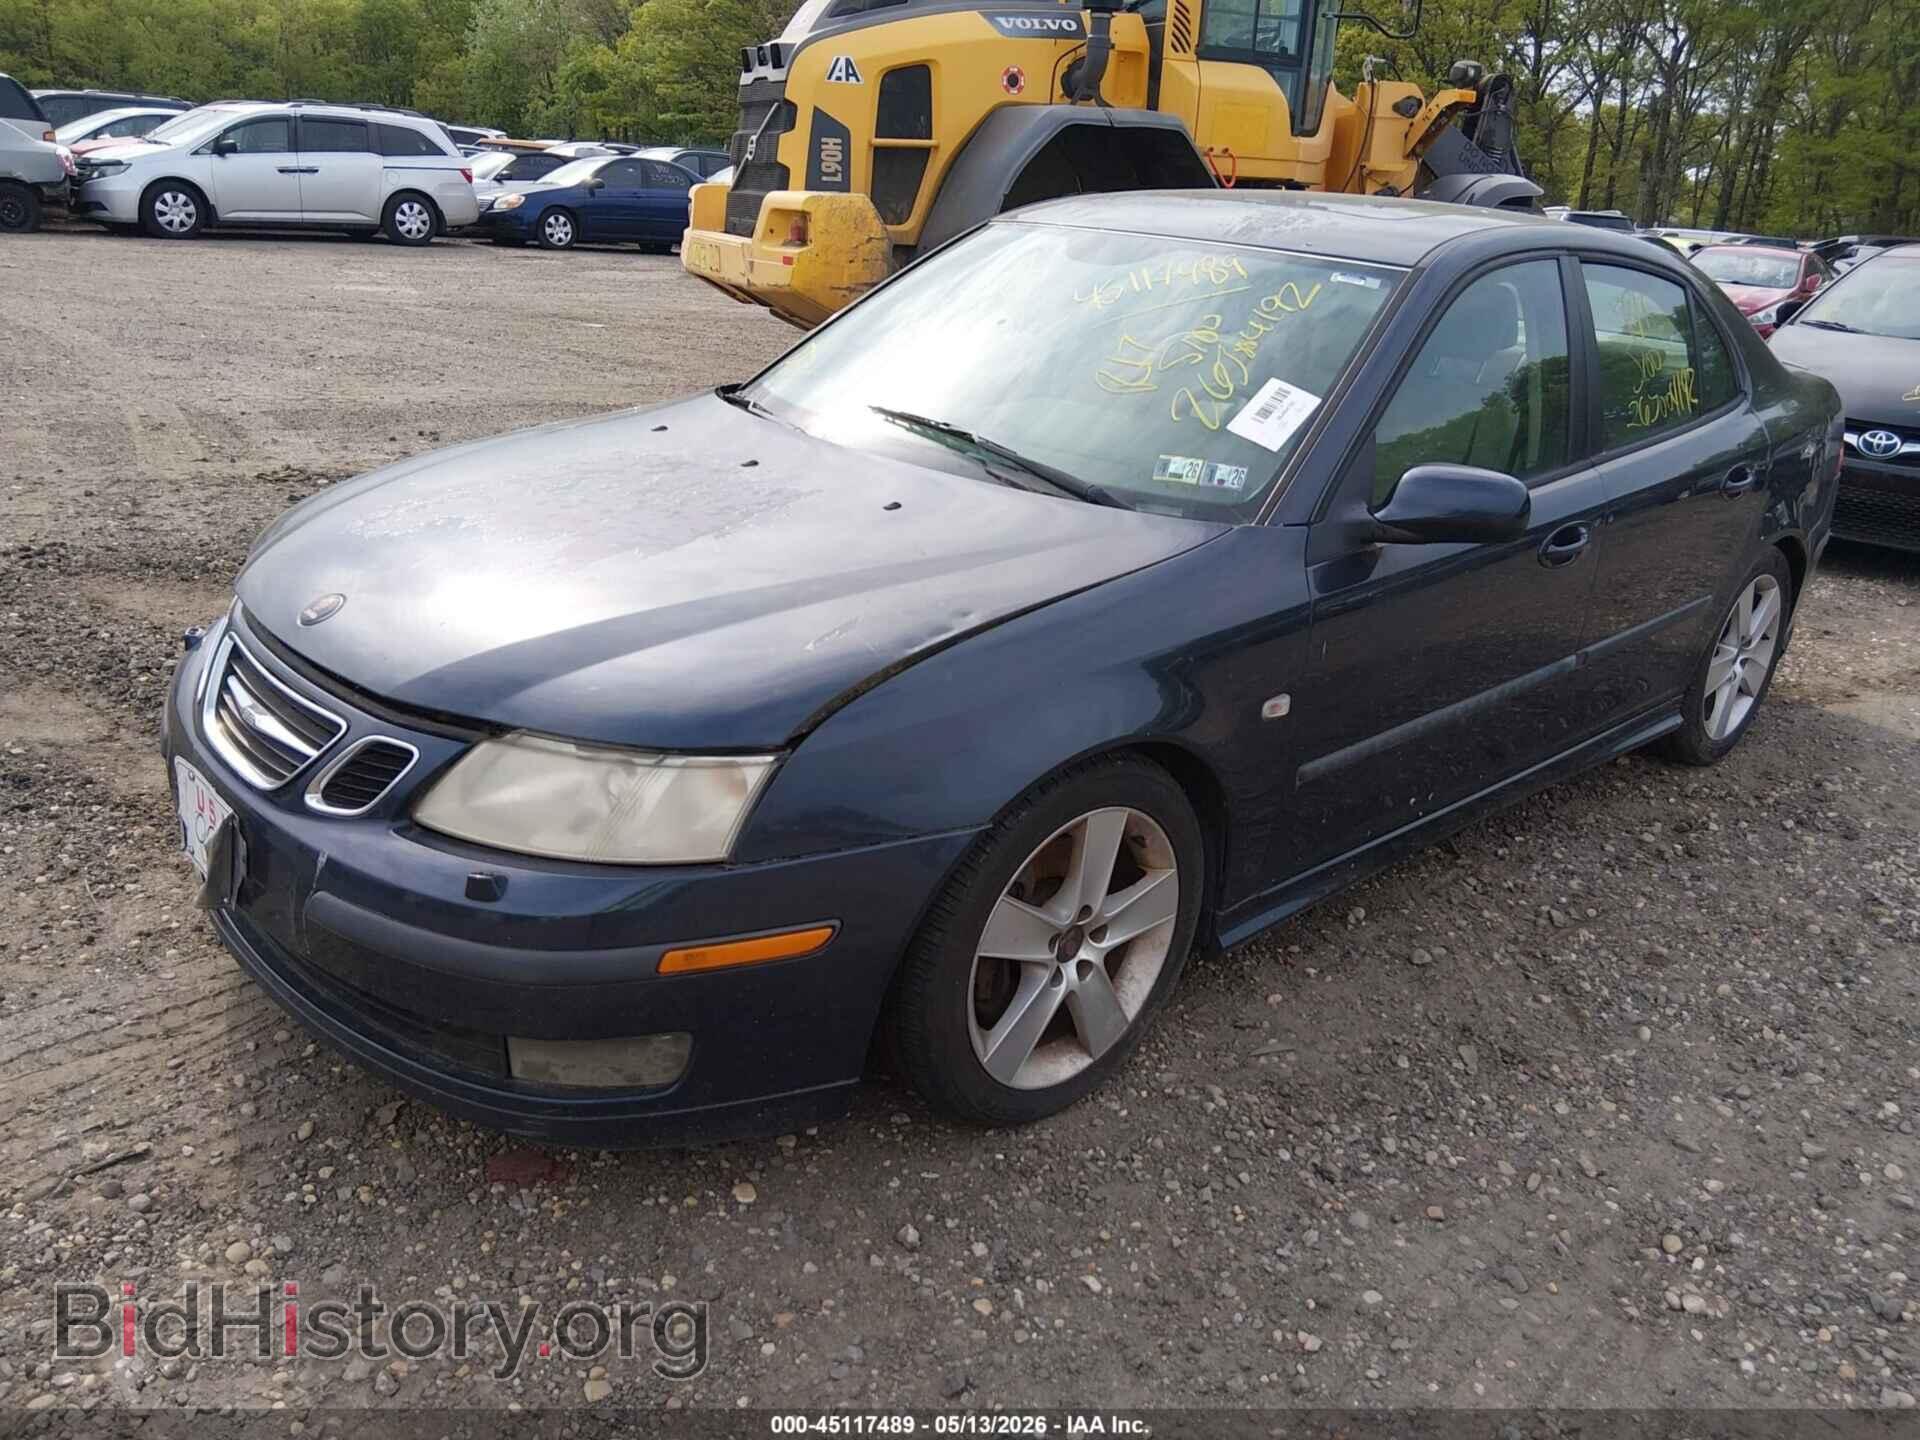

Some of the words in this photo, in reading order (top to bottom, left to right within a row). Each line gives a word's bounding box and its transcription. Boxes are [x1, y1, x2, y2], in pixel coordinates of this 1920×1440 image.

[995, 16, 1078, 31] VOLVO
[820, 137, 843, 182] L90H
[1230, 468, 1245, 487] 26
